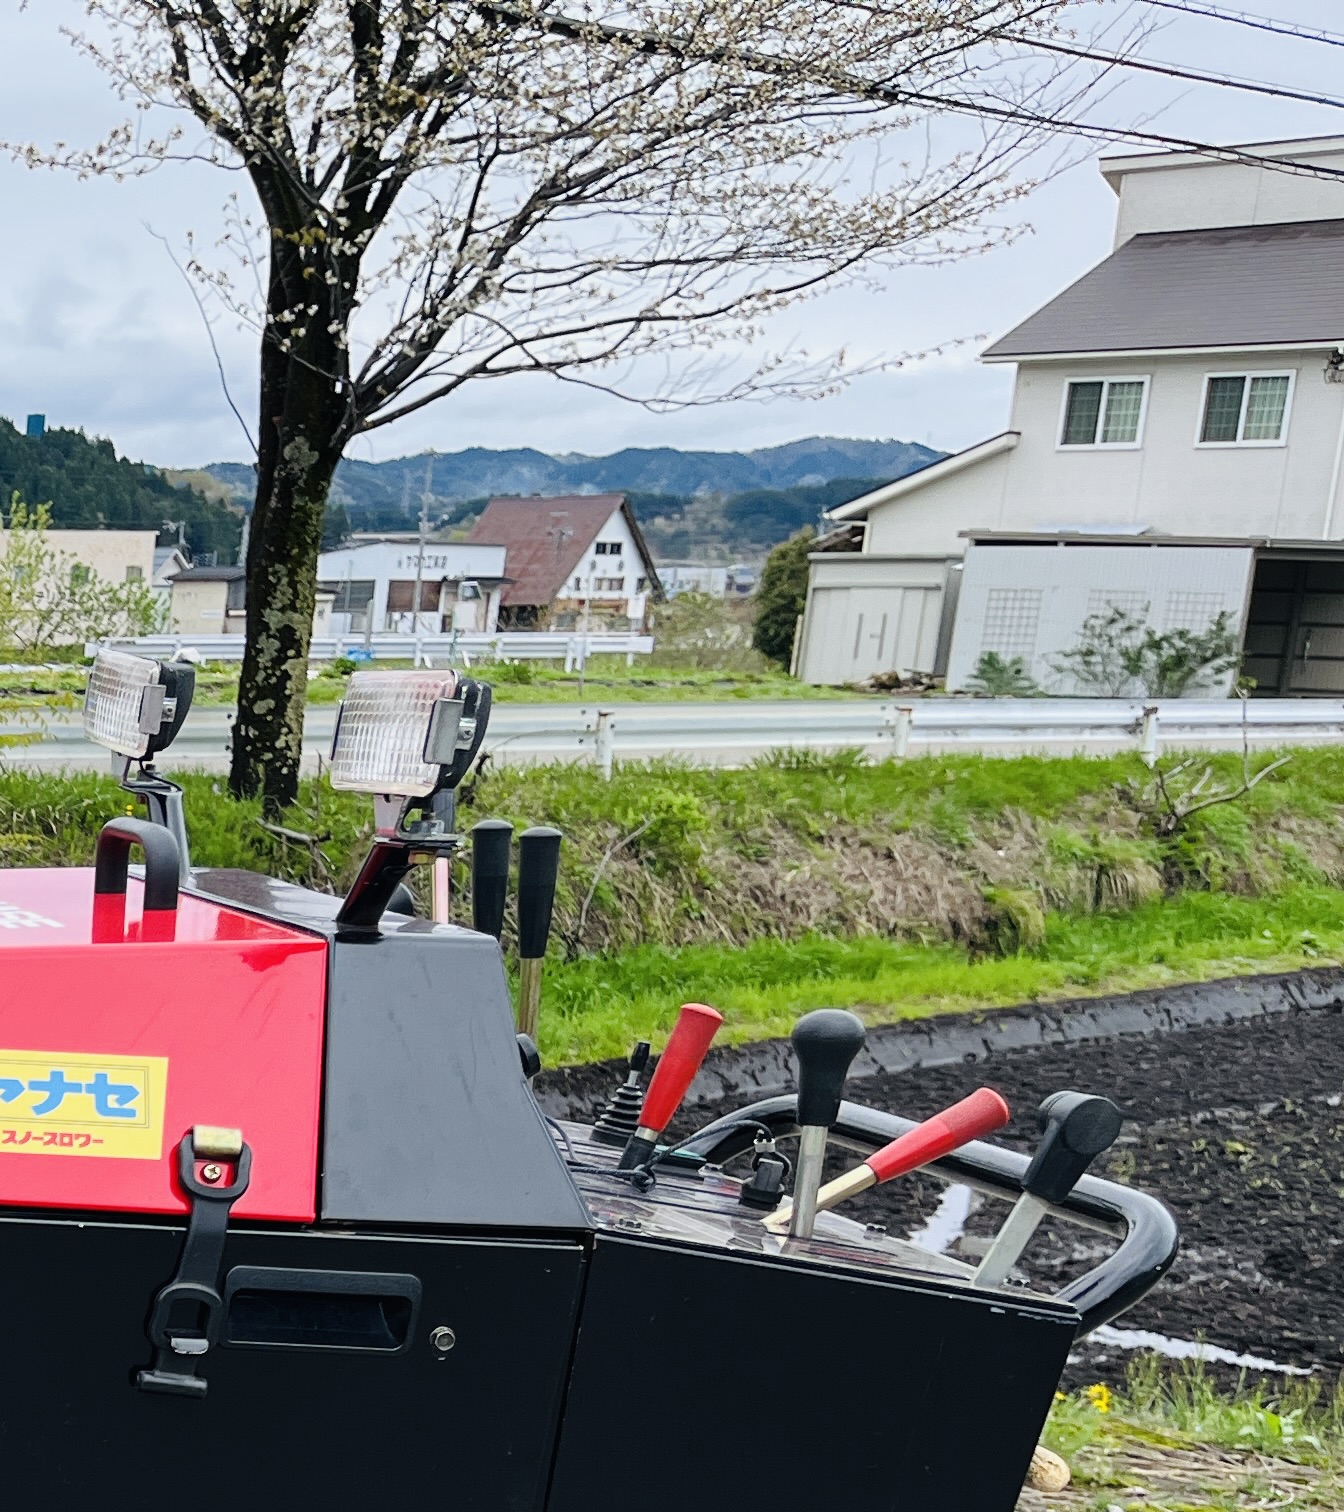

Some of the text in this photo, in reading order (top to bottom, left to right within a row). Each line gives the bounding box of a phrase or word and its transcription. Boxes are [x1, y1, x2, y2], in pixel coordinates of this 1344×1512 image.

[1, 1129, 104, 1148] スノースロワー
